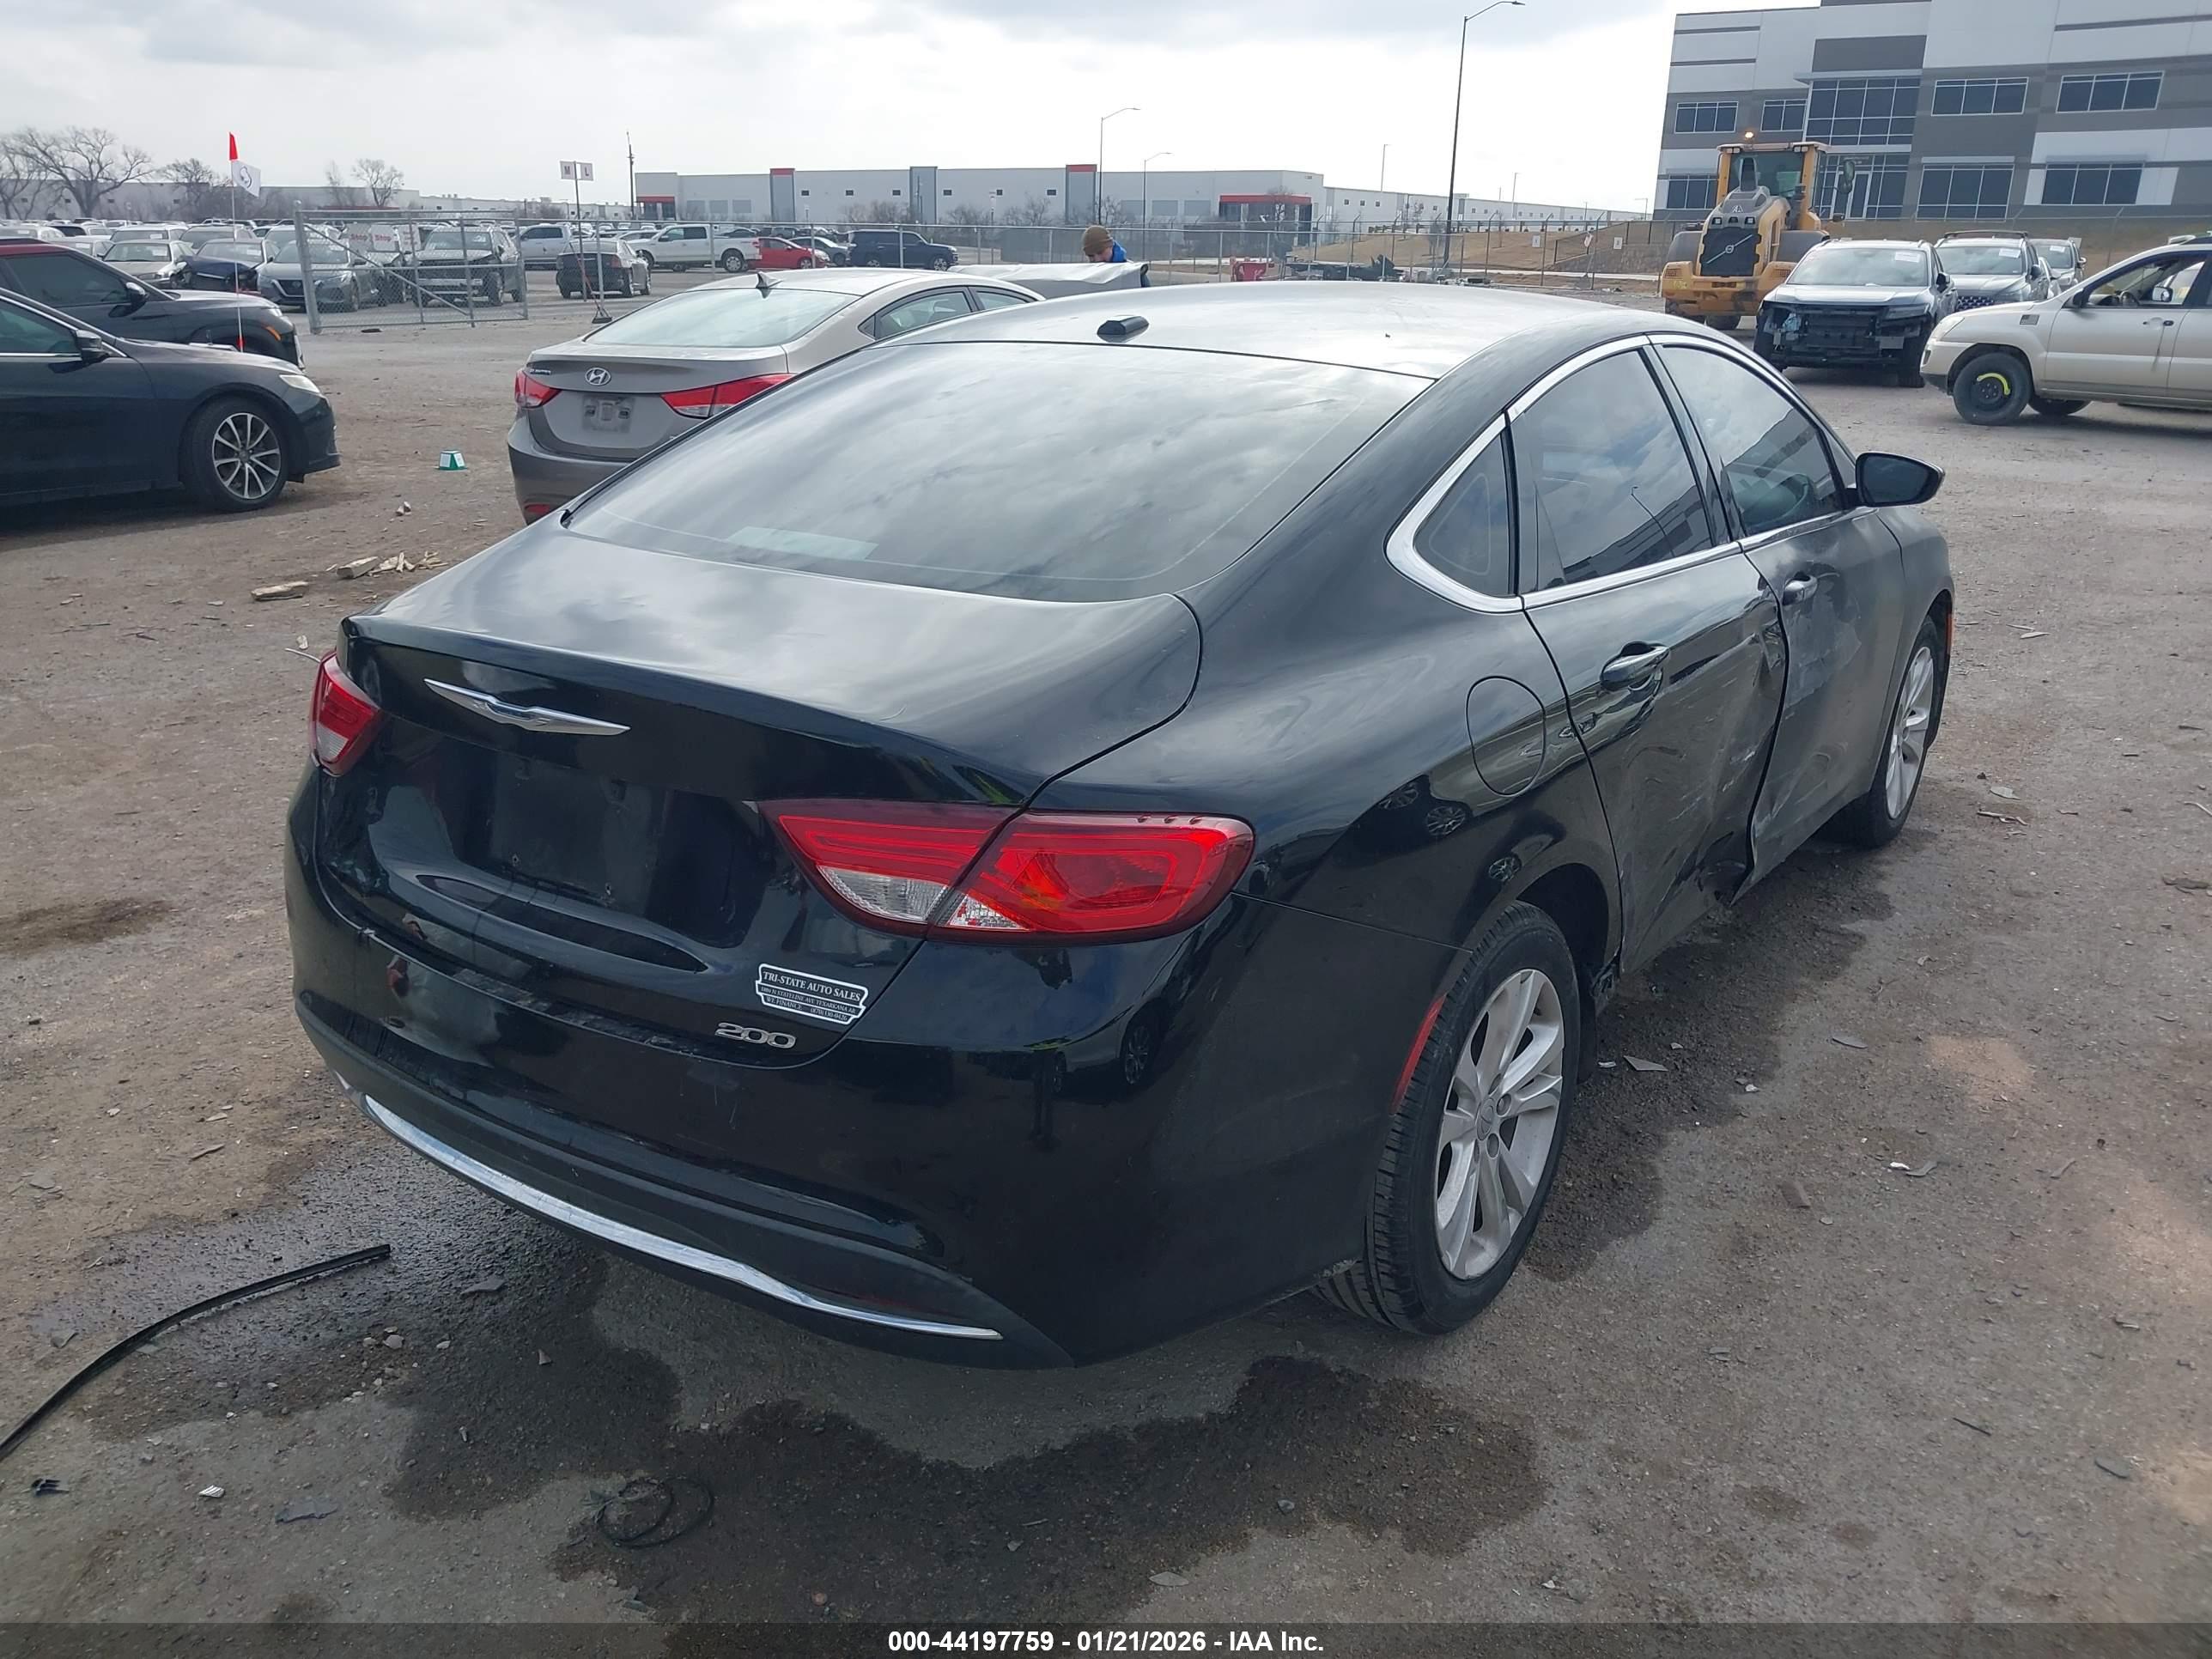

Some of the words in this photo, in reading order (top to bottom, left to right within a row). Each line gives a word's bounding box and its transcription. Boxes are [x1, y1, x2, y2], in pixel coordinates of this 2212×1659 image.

[374, 234, 392, 242] Stop
[763, 971, 806, 989] TRI-STATE
[806, 981, 833, 995] AUTO
[833, 988, 861, 1001] SALES
[776, 999, 803, 1011] FINANCE
[777, 990, 804, 1001] STATELINE
[816, 999, 848, 1012] TEXARKANA
[714, 1022, 797, 1048] 200
